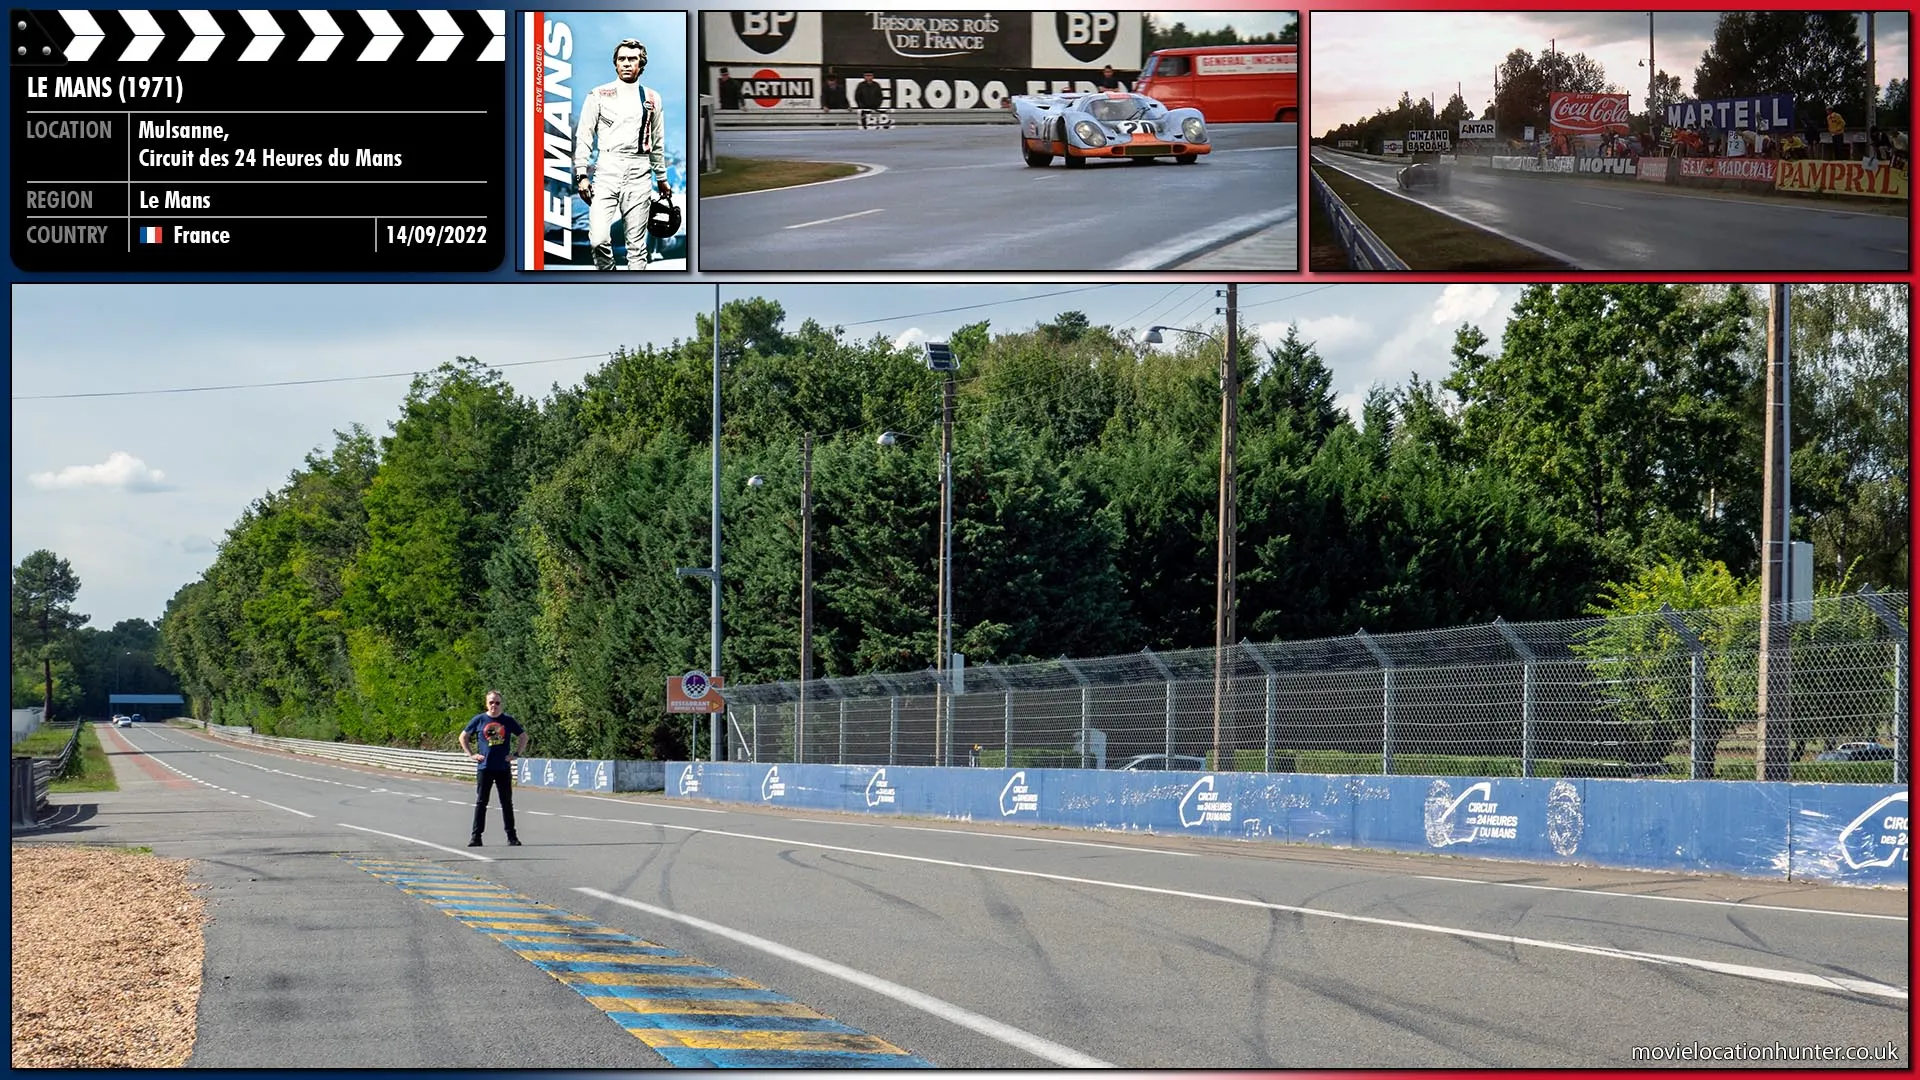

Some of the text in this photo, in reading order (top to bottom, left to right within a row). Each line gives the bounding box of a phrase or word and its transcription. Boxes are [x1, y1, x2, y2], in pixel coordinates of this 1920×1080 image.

[742, 12, 794, 36] BP
[928, 18, 959, 31] DES
[1064, 12, 1116, 45] BP
[896, 31, 985, 49] DE FRANCE
[741, 81, 811, 96] ARTINI
[1668, 98, 1788, 129] MARTELL
[1410, 130, 1448, 141] CINZANO
[1461, 123, 1494, 134] ANTAR
[543, 20, 573, 261] LE MANS
[1408, 141, 1449, 151] BARDAHL
[1579, 158, 1637, 174] MOTUL
[1717, 160, 1776, 179] MARCHAL
[1778, 162, 1899, 195] PAMPRYL
[1468, 802, 1498, 813] CIRCUIT
[1477, 814, 1487, 825] 24
[1487, 815, 1519, 827] HEURES
[1480, 826, 1517, 839] DU MANS
[1880, 835, 1897, 845] DES
